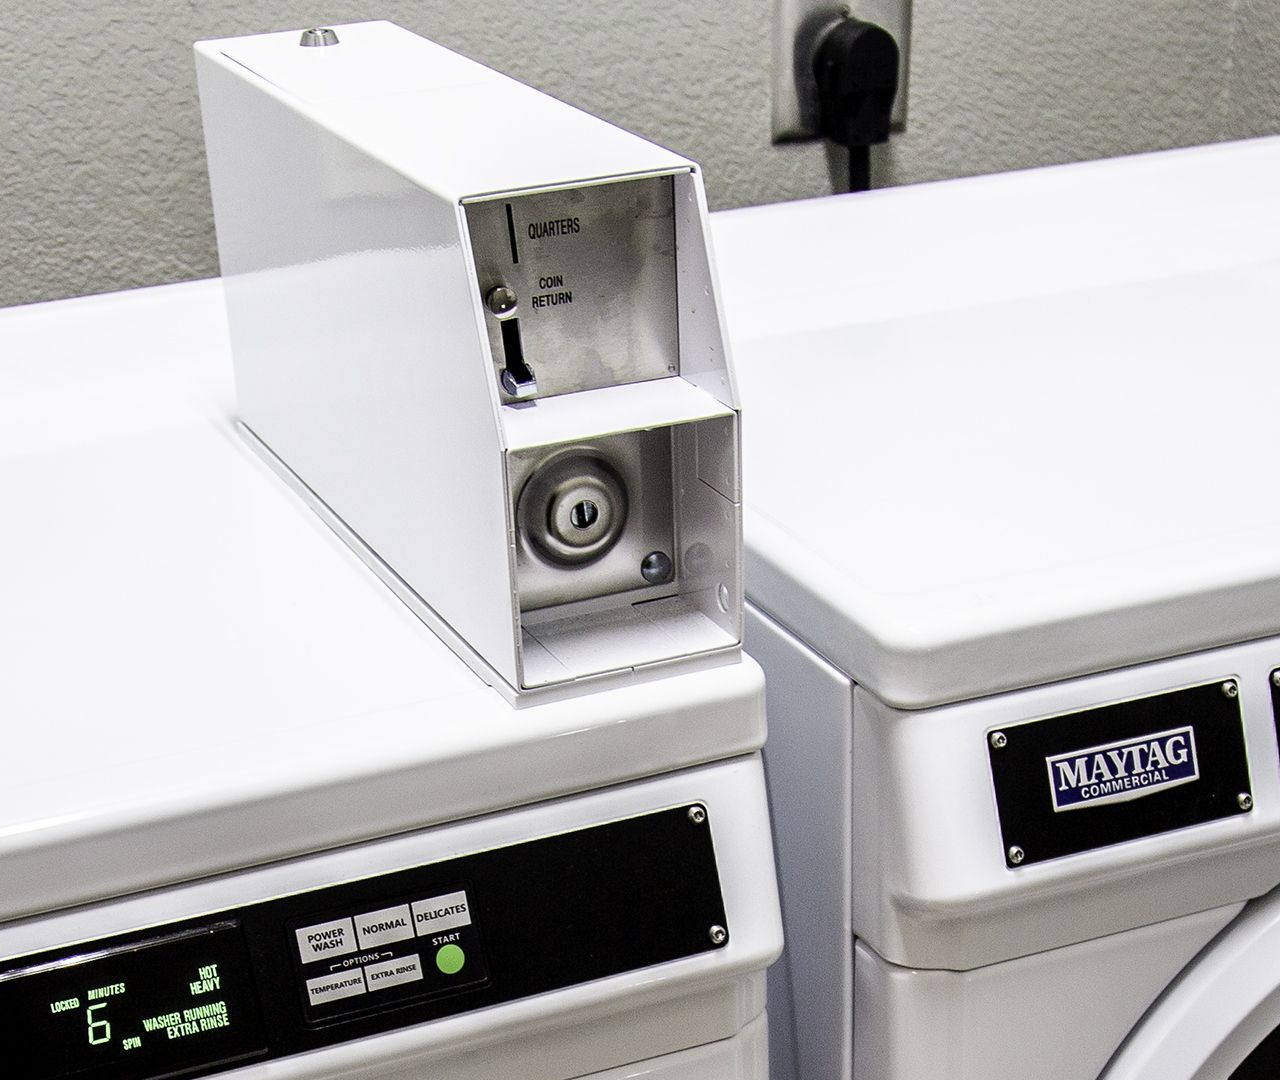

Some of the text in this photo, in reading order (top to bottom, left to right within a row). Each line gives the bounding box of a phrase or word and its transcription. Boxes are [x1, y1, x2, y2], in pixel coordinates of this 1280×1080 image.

[528, 217, 580, 240] QUARTERS
[539, 275, 564, 290] COIN
[532, 291, 573, 308] RETURN
[1055, 736, 1188, 791] MAYTAG
[1081, 769, 1170, 799] COMMERCIAL
[416, 903, 467, 923] DELICATES
[307, 928, 345, 944] POWER
[362, 918, 408, 936] NORMAL
[312, 938, 344, 953] WASH
[432, 932, 461, 946] START
[342, 952, 380, 967] OPTIONS
[198, 964, 218, 980] HOT
[370, 963, 417, 982] EXTRA RINSE
[87, 982, 126, 1001] MINUTES
[189, 976, 221, 996] HEAVY
[310, 977, 363, 996] TEMPERATURE
[50, 997, 80, 1014] LOCKED
[86, 1002, 111, 1046] 6
[142, 1001, 228, 1033] WASHER RUNNING
[166, 1013, 230, 1040] EXTRA RINSE
[122, 1036, 142, 1051] SPIN
